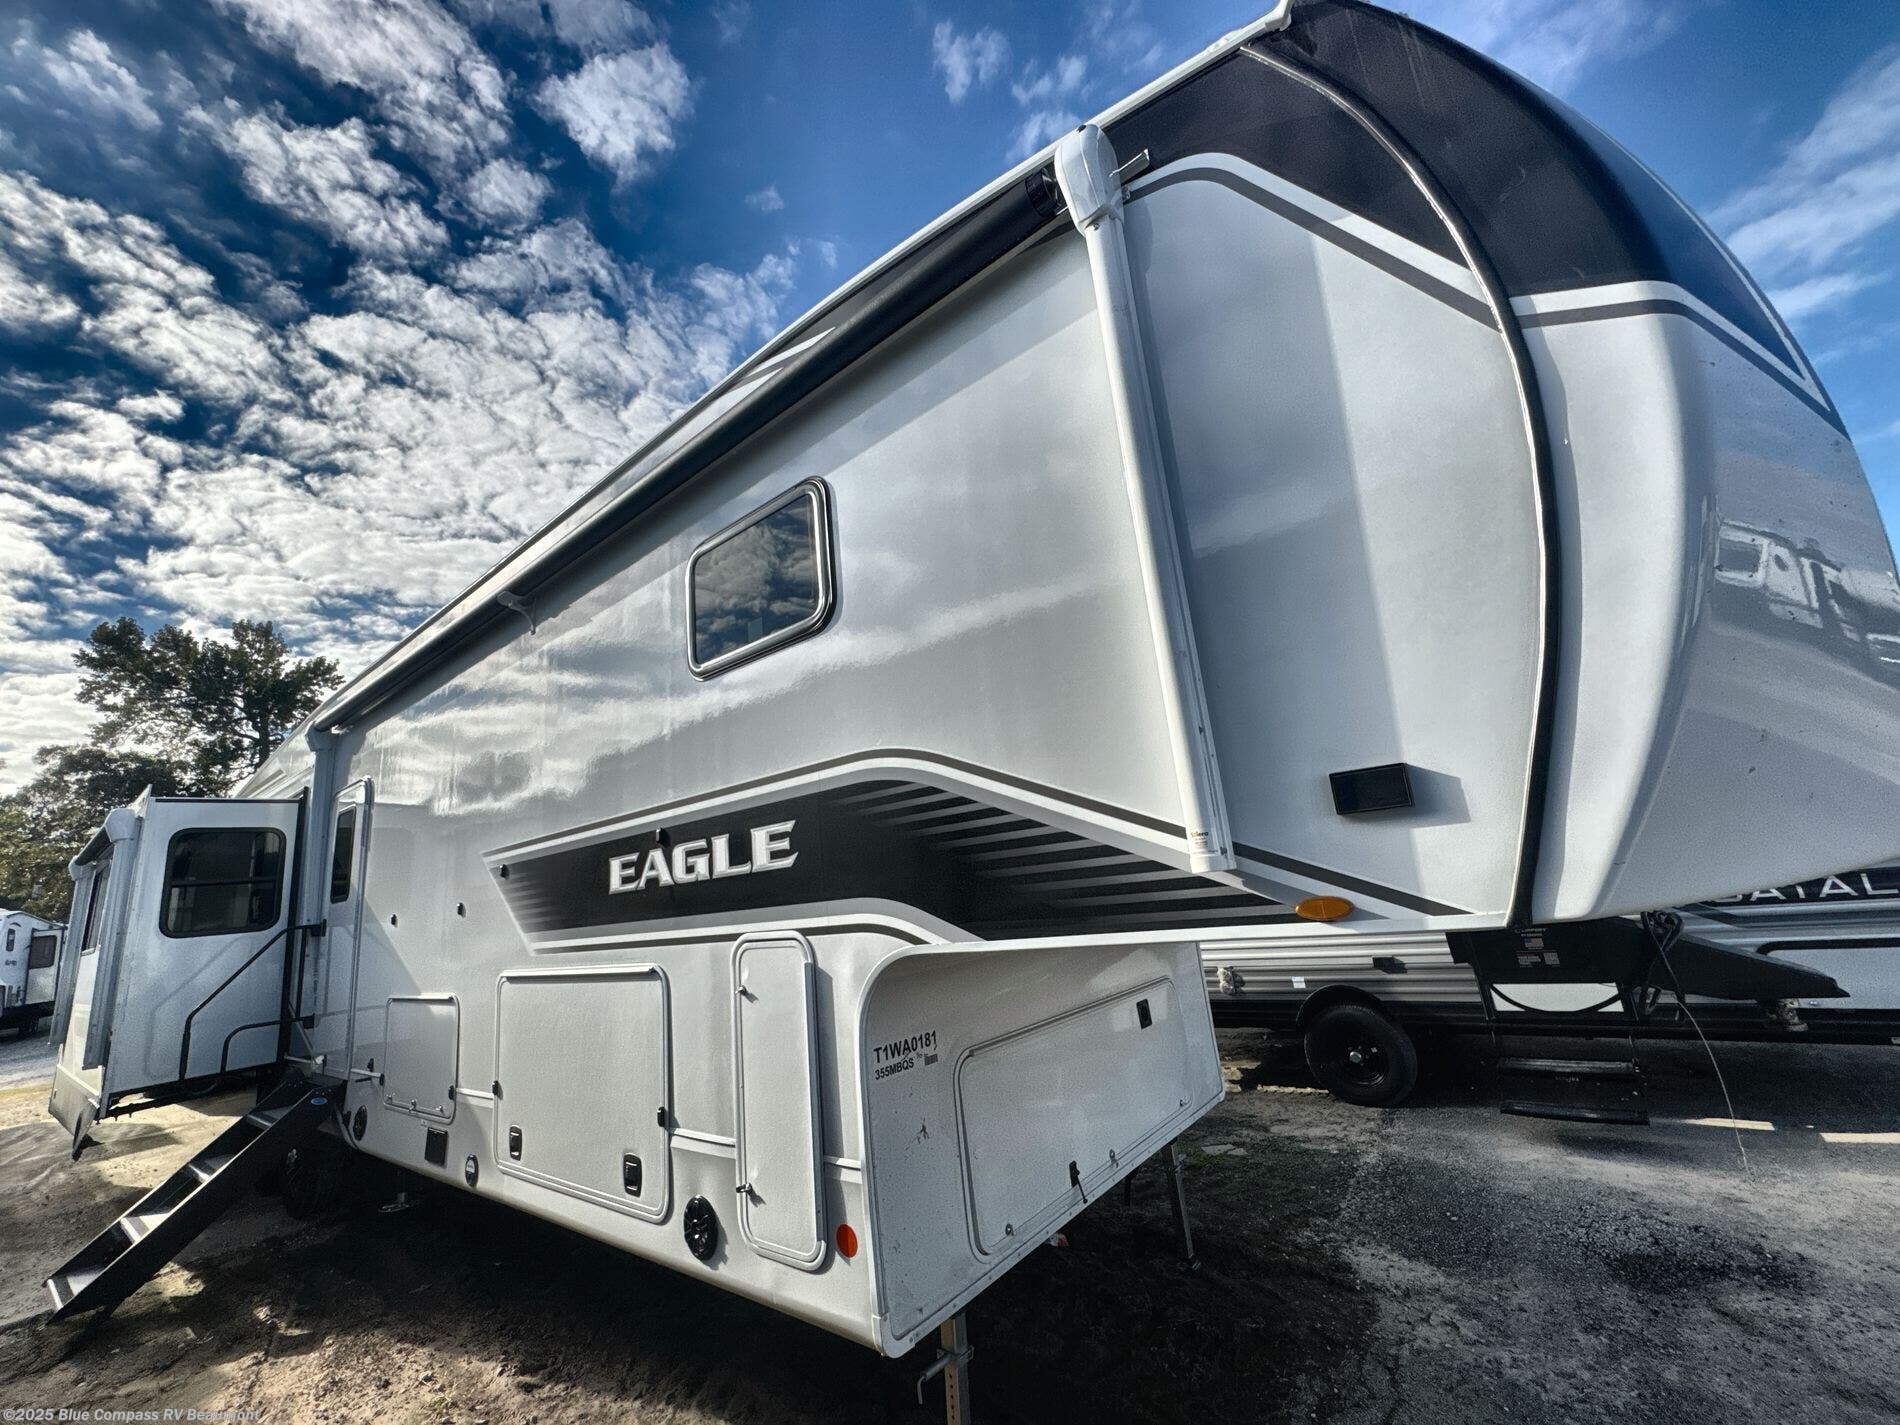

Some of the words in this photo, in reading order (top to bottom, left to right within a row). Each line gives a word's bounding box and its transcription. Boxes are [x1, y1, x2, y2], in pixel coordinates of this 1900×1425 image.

[609, 820, 799, 894] EAGLE
[873, 1029, 937, 1064] T1WA0181
[874, 1057, 915, 1080] 355MBQS
